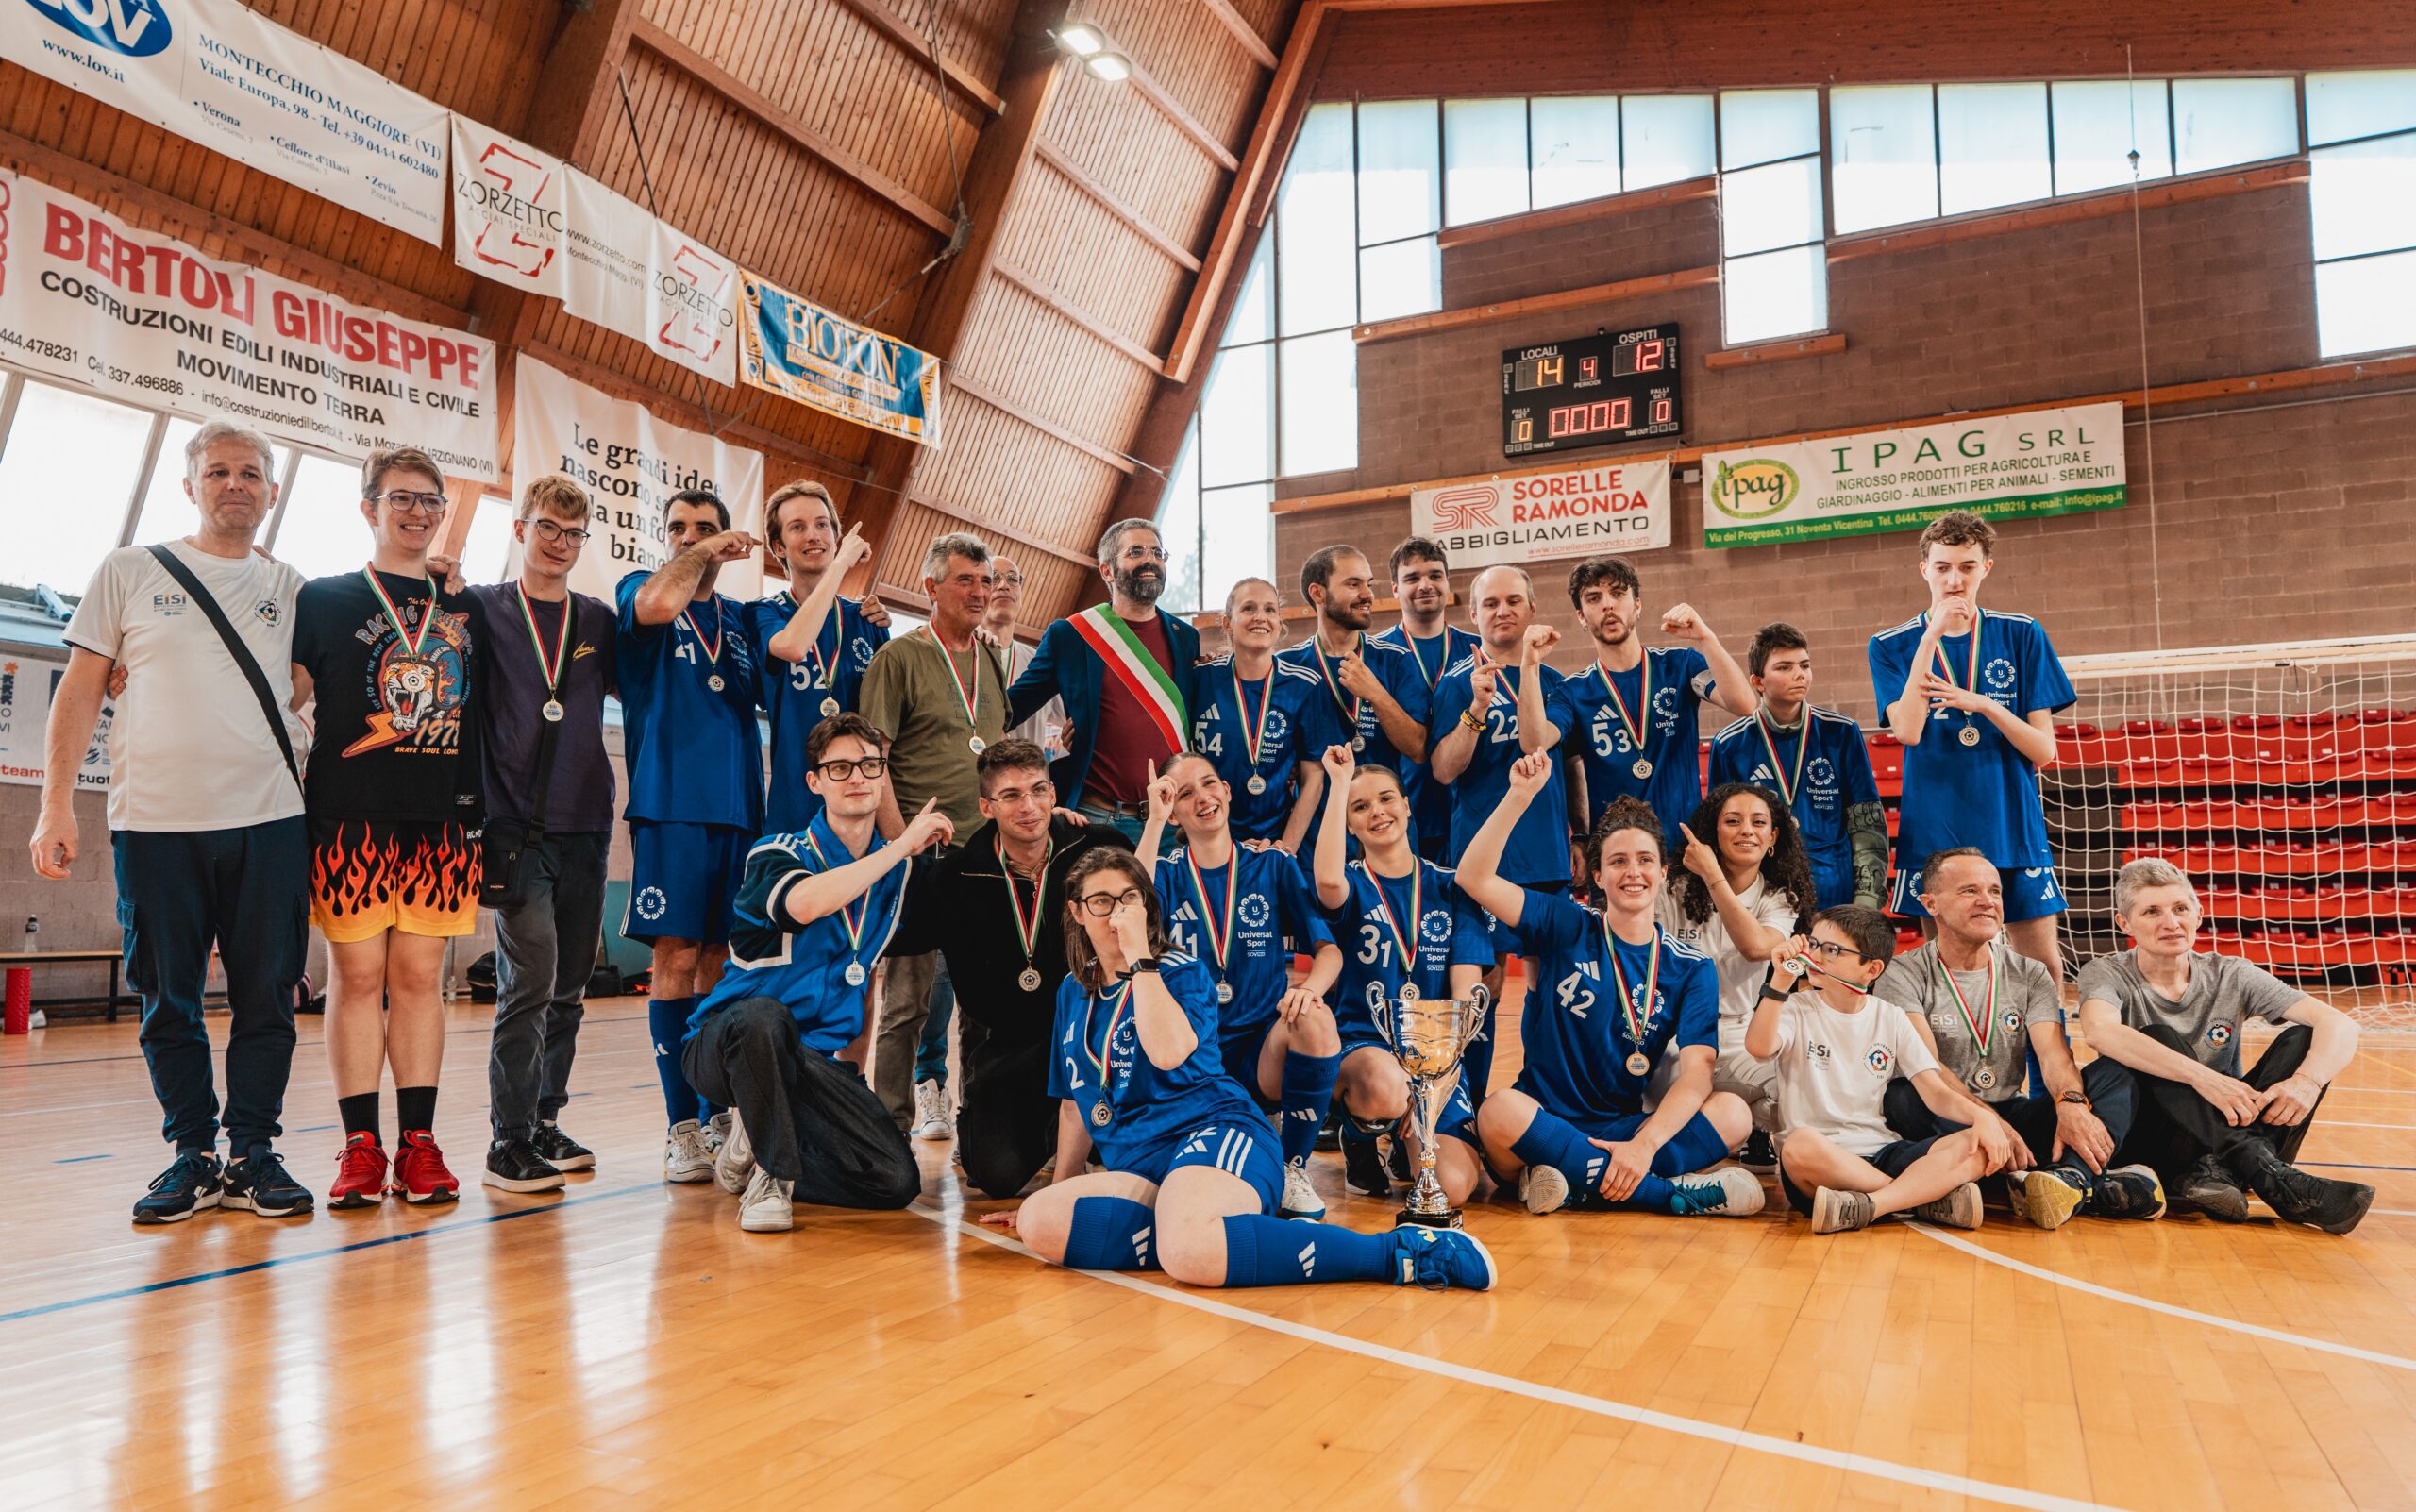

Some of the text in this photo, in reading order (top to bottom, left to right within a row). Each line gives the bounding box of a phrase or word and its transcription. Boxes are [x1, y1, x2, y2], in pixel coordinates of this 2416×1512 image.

[34, 0, 153, 48] OV
[42, 38, 125, 83] www.lov.it
[198, 33, 442, 160] MONTECCHIO MAGGIORE (VI)
[201, 101, 242, 127] Verona
[198, 57, 439, 179] Viale Europa, 98 Tel. +39 0444 602480
[277, 136, 313, 160] Cellore
[371, 176, 396, 195] Zevio
[458, 172, 564, 233] ZORZETTO
[566, 228, 646, 274] www.zorzetto.com
[43, 201, 255, 327] BERTOLI
[273, 290, 478, 390] GIUSEPPE
[652, 270, 734, 328] ZORZETTO
[40, 270, 480, 418] COSTRUZIONI EDILI INDUSTRIALI E CIVILE
[1520, 345, 1558, 361] LOCALI
[1619, 329, 1658, 344] OSPITI
[1536, 357, 1563, 387] 14
[1583, 359, 1595, 378] 4
[1636, 341, 1662, 372] 12
[176, 349, 386, 425] MOVIMENTO TERRA
[88, 355, 106, 376] Cel.
[109, 365, 184, 396] 337.496886
[354, 433, 371, 448] Via
[479, 460, 493, 475] (VI)
[1551, 400, 1630, 437] 0000
[1656, 400, 1669, 422] 0
[1518, 420, 1531, 441] 0
[574, 422, 599, 456] Le
[606, 444, 669, 485] grandi
[1836, 450, 2091, 492] INGROSSO PRODOTTI PER AGRICOLTURA E
[560, 454, 651, 505] nascono
[1513, 470, 1623, 501] SORELLE
[1817, 465, 2115, 509] GIARDINAGGIO ALIMENTI PER ANIMALI SEMENTI
[1513, 490, 1648, 524] RAMONDA
[1708, 532, 1722, 543] Via
[1723, 530, 1736, 542] del
[1738, 526, 1783, 543] Progresso,
[1785, 526, 1795, 536] 31
[1796, 523, 1832, 534] Noventa
[1834, 517, 1873, 530] Vicentina
[1878, 515, 1893, 526] Tel.
[2031, 496, 2063, 511] e-mail:
[2064, 490, 2122, 507] info@ipag.it
[1435, 516, 1649, 551] ABBIGLIAMENTO
[1527, 536, 1650, 555] www.sorelleramonda.com
[790, 662, 828, 691] 52
[1194, 721, 1223, 757] 54
[1488, 710, 1519, 744] 22
[1592, 722, 1632, 757] 53
[394, 746, 418, 754] BRAVE
[421, 747, 440, 755] SOUL
[1168, 922, 1198, 958] 41
[1237, 930, 1273, 939] Universal
[1246, 940, 1267, 949] Sport
[1357, 924, 1392, 968] 31
[1426, 953, 1446, 962] Sport
[1556, 970, 1596, 1019] 42
